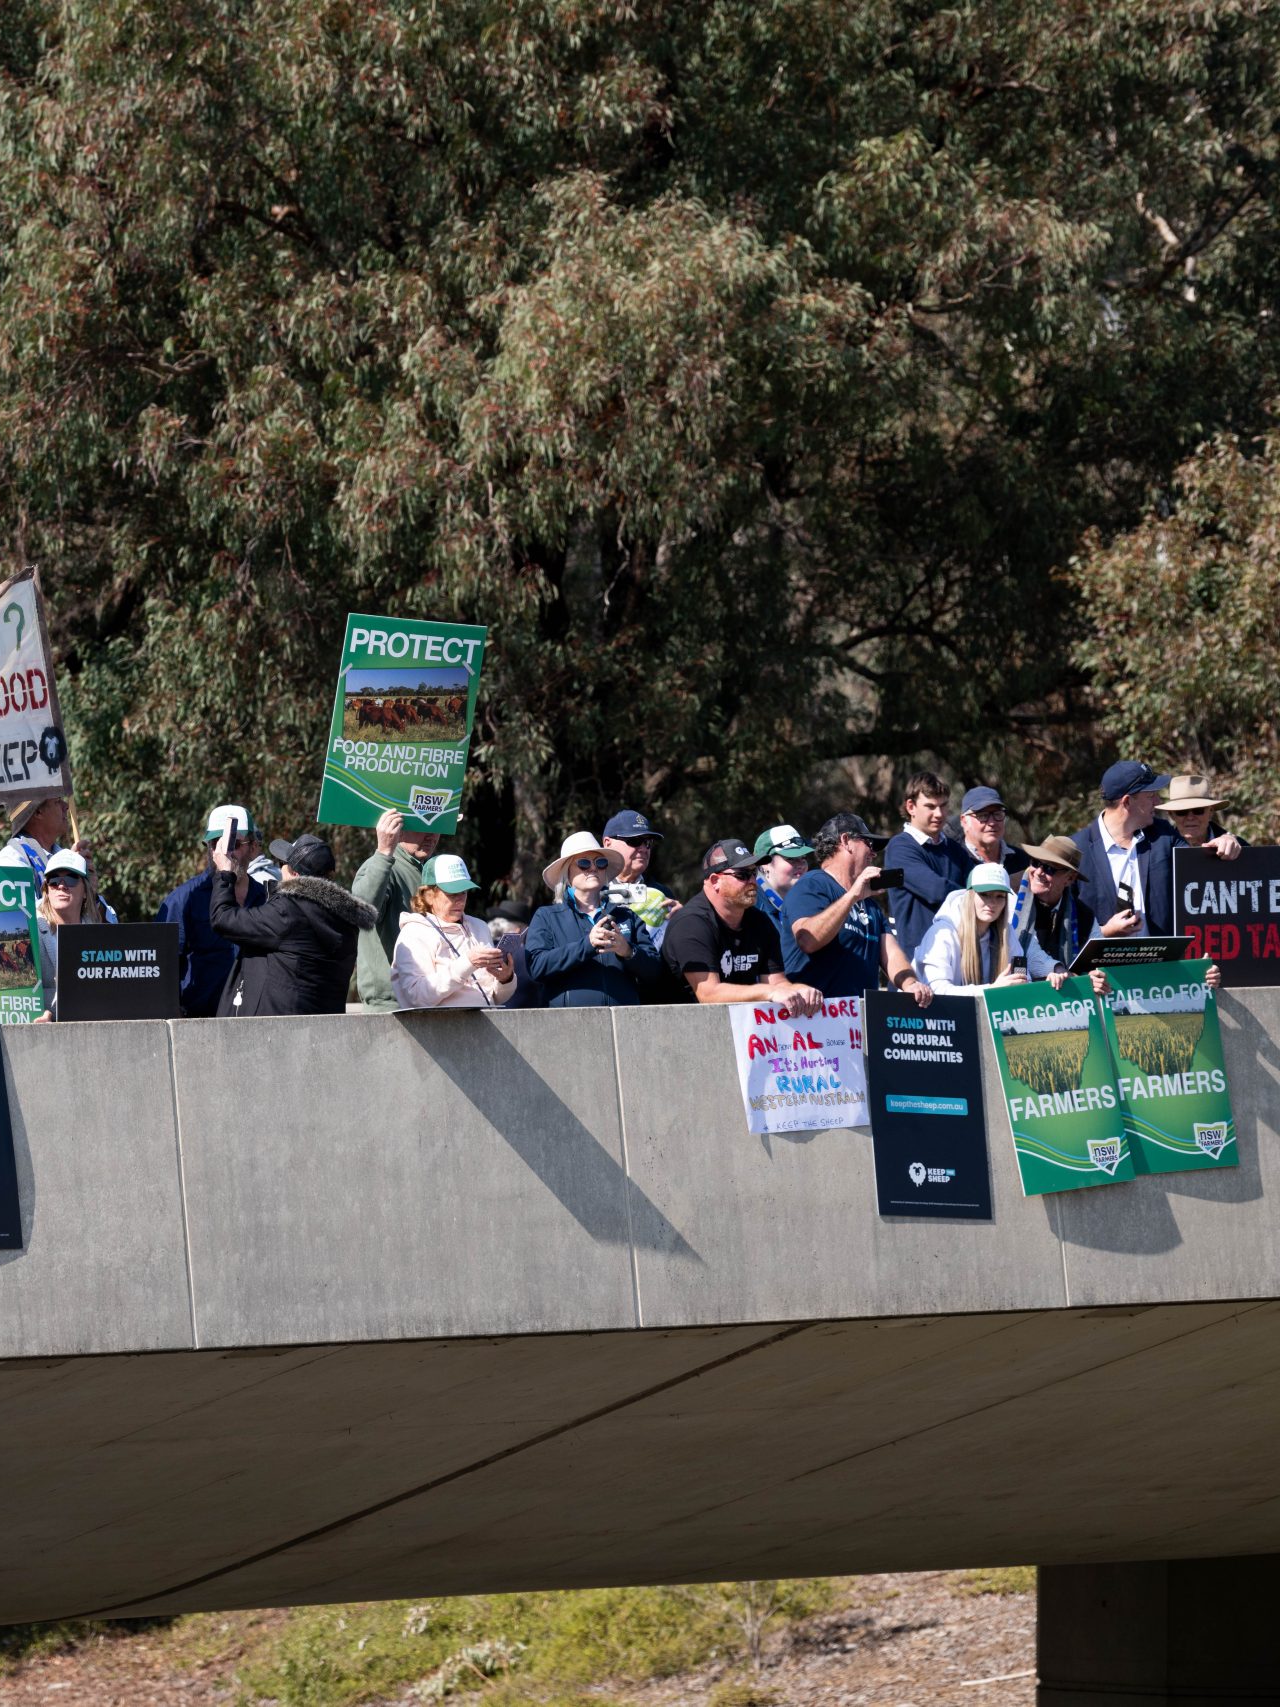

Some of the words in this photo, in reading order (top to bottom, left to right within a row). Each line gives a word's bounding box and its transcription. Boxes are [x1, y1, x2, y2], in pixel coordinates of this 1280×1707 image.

[349, 627, 481, 665] PROTECT
[332, 739, 379, 758] FOOD
[382, 744, 416, 760] AND
[419, 748, 464, 765] FIBRE
[344, 755, 449, 778] PRODUCTION
[415, 793, 444, 806] nsw
[414, 803, 443, 813] FARMERS
[1183, 879, 1263, 915] CAN'T
[1184, 923, 1241, 960] RED
[81, 949, 123, 963] STAND
[124, 949, 157, 962] WITH
[77, 965, 103, 980] OUR
[104, 965, 160, 979] FARMERS
[1104, 988, 1144, 1009] FAIR
[1149, 985, 1176, 1003] GO
[1179, 983, 1213, 1001] FOR
[1, 996, 42, 1012] FIBRE
[753, 1008, 790, 1025] NO
[991, 1007, 1028, 1029] FAIR
[1033, 1004, 1058, 1022] GO
[1061, 998, 1096, 1018] FOR
[886, 1016, 924, 1030] STAND
[925, 1019, 956, 1031] WITH
[891, 1033, 915, 1045] OUR
[916, 1034, 953, 1047] RURAL
[884, 1048, 963, 1063] COMMUNITIES
[767, 1057, 798, 1073] It's
[800, 1056, 839, 1072] Hurting
[776, 1075, 841, 1094] RURAL
[1117, 1069, 1226, 1101] FARMERS
[749, 1093, 807, 1112] WESTERN
[809, 1090, 865, 1107] AUSTRALIA
[890, 1099, 963, 1111] keepthesheep.com.au
[1009, 1085, 1116, 1122] FARMERS
[776, 1120, 799, 1130] KEEP
[820, 1118, 844, 1127] SHEEP
[1200, 1129, 1222, 1141] nsw
[1201, 1138, 1224, 1147] FARMERS
[1093, 1144, 1115, 1157] nsw
[1095, 1154, 1118, 1164] FARMERS
[928, 1175, 950, 1183] SHEEP
